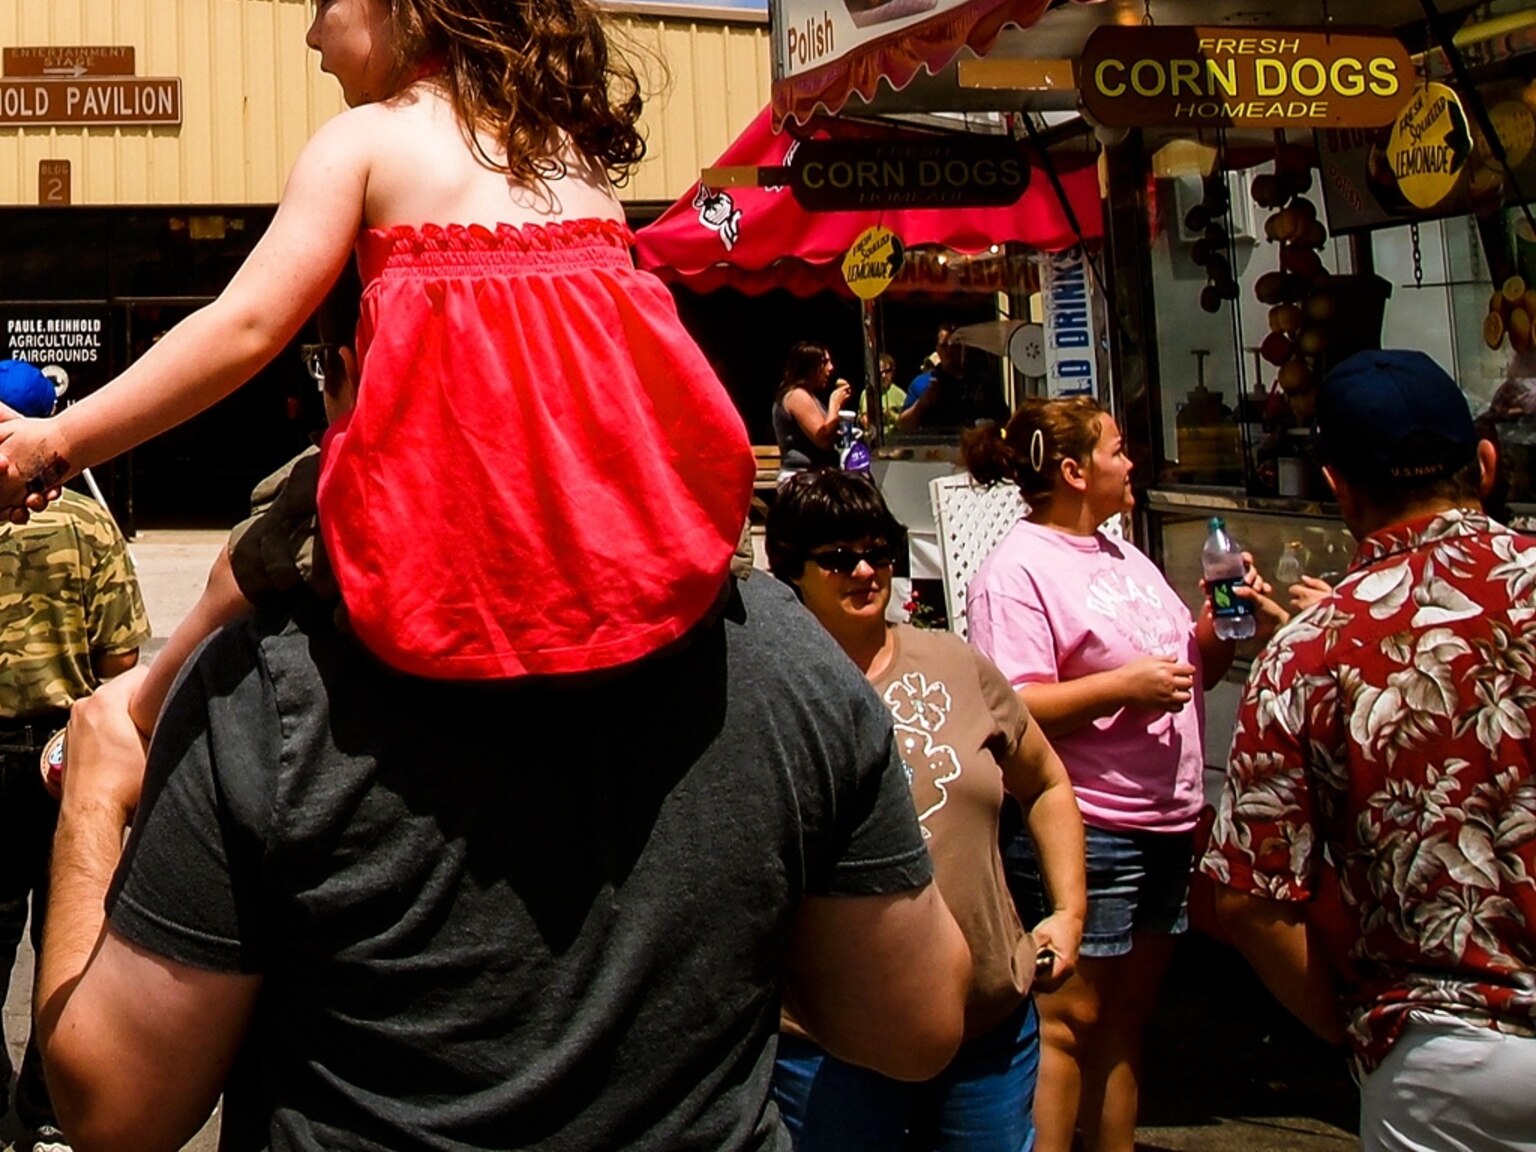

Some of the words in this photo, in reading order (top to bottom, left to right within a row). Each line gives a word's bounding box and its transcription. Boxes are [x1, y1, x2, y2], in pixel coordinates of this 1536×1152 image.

[788, 9, 834, 71] Polish
[1198, 38, 1300, 55] FRESH
[12, 48, 127, 58] ENTERTAINMENT
[44, 57, 95, 67] STAGE
[1094, 58, 1237, 97] CORN
[1255, 57, 1399, 97] DOGS
[67, 85, 172, 115] PAVILION
[1175, 101, 1328, 118] HOMEADE
[1399, 95, 1424, 137] FRESH
[1395, 144, 1449, 179] LEMONADE
[802, 162, 906, 188] CORN
[919, 159, 1021, 188] DOGS
[47, 178, 63, 200] 2
[9, 334, 101, 348] AGRICULTURAL
[12, 349, 97, 362] FAIRGROUNDS
